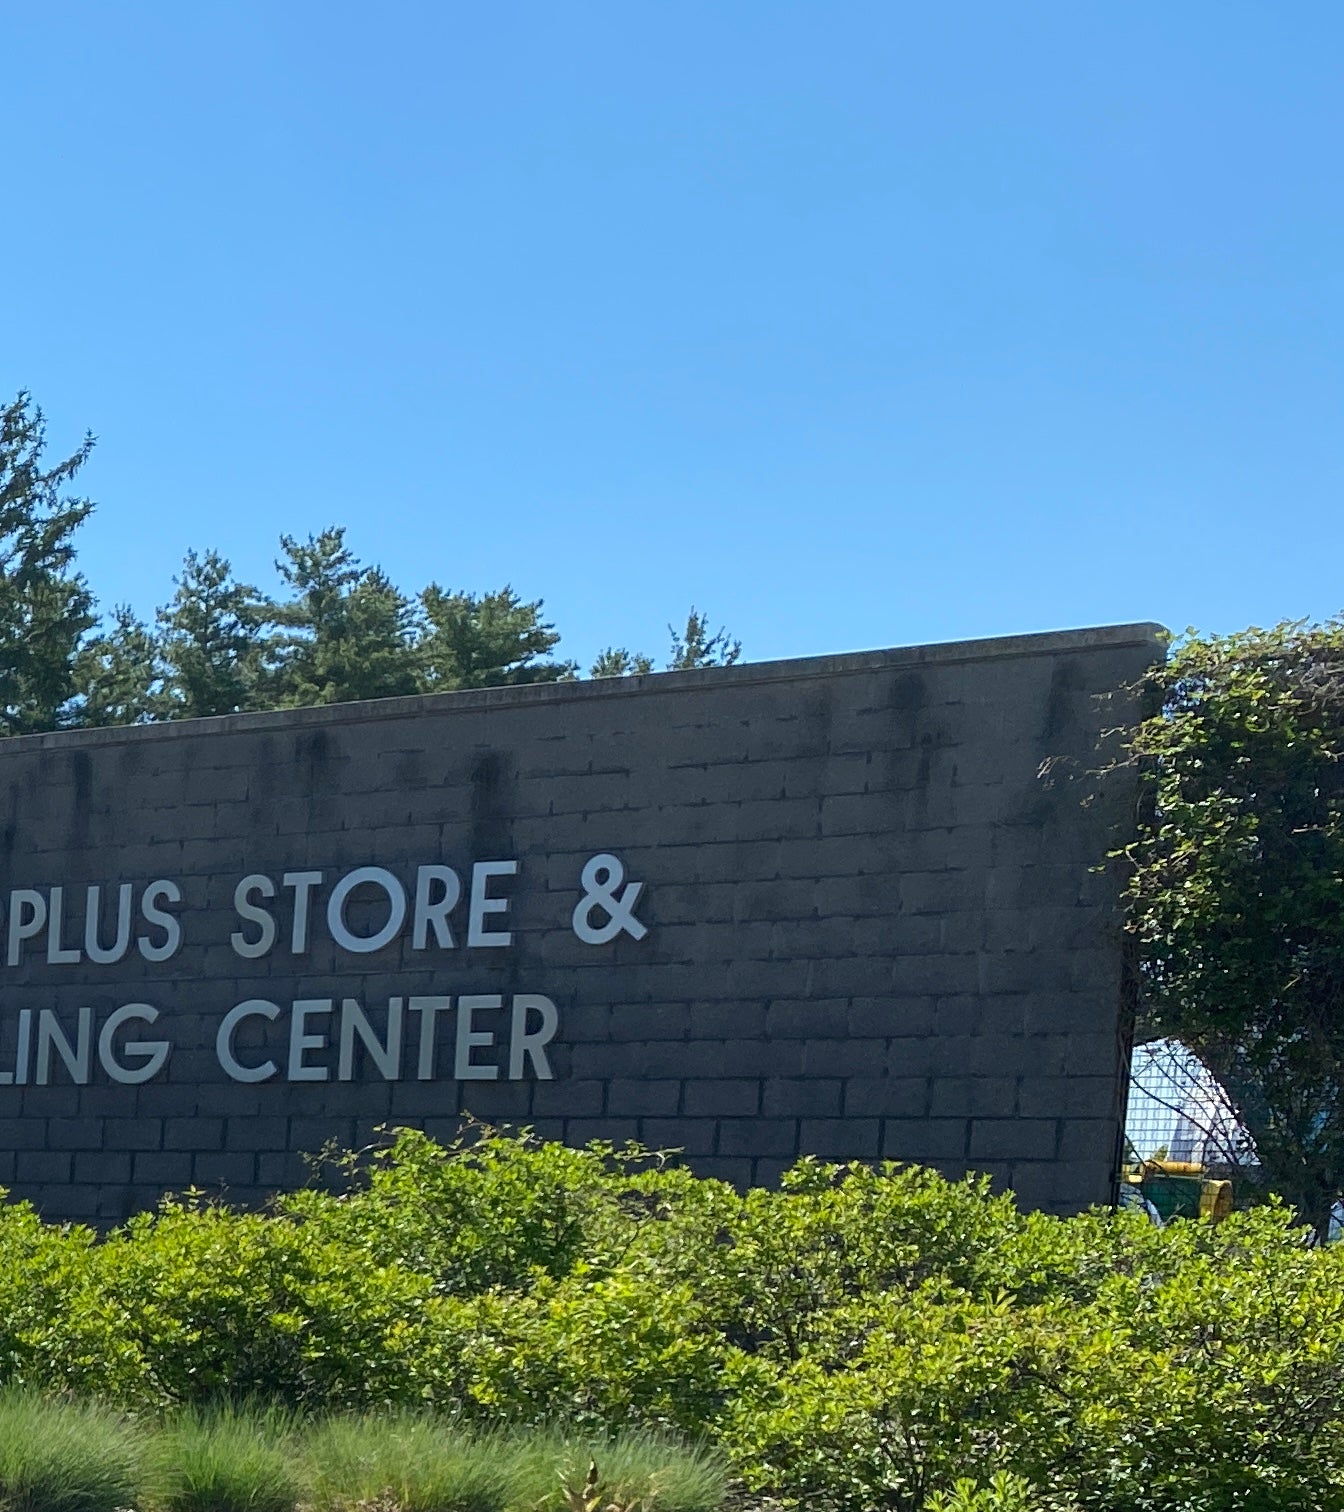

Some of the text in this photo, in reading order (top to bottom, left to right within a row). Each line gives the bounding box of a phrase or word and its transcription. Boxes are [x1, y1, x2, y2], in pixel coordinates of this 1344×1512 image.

[230, 860, 518, 959] STORE
[572, 852, 649, 946] &
[216, 994, 560, 1083] CENTER
